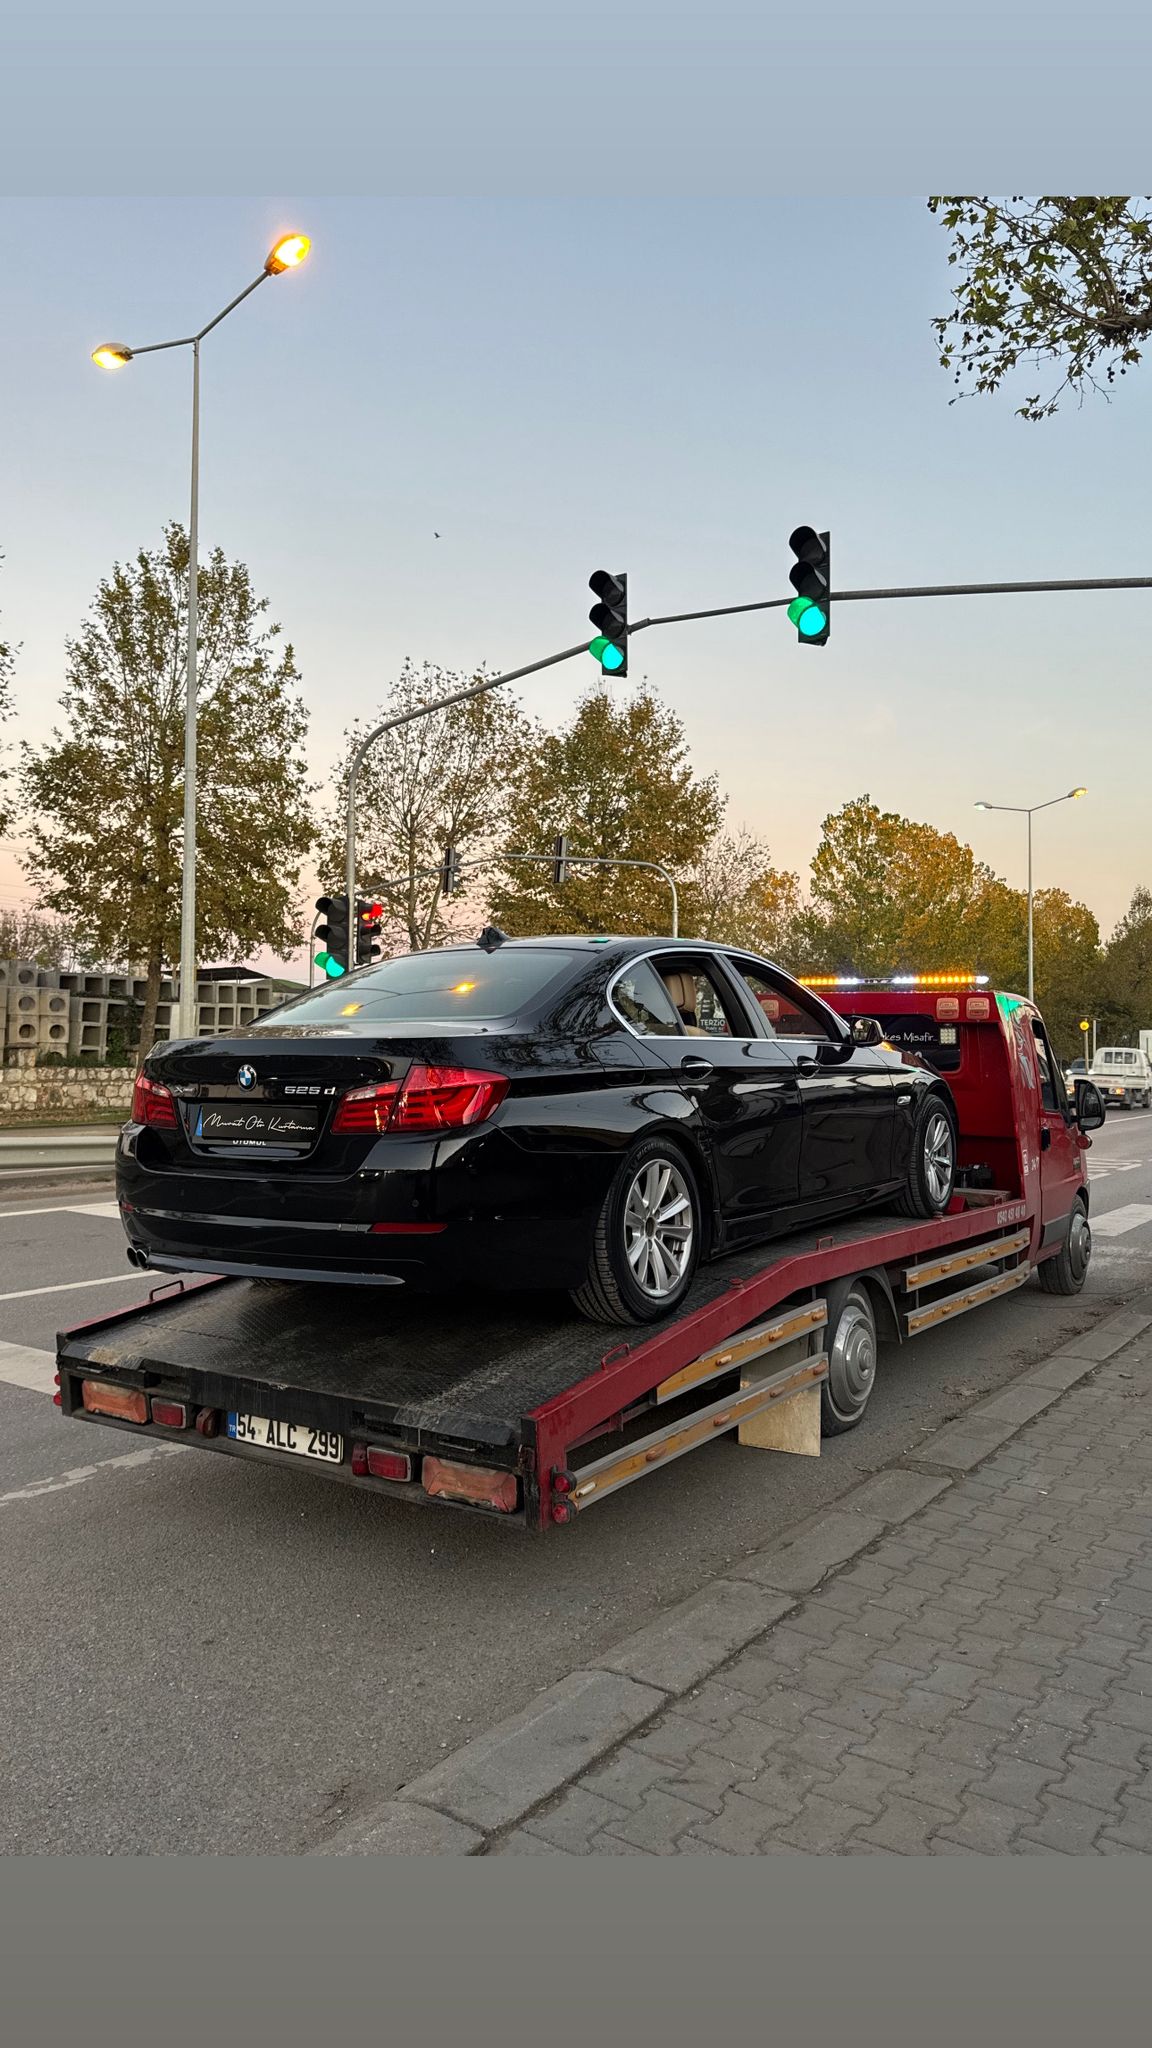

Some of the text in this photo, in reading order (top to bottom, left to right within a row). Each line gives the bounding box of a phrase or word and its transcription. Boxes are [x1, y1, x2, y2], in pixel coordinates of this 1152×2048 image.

[229, 1424, 237, 1433] TR
[238, 1414, 340, 1460] 54 ALC 299
